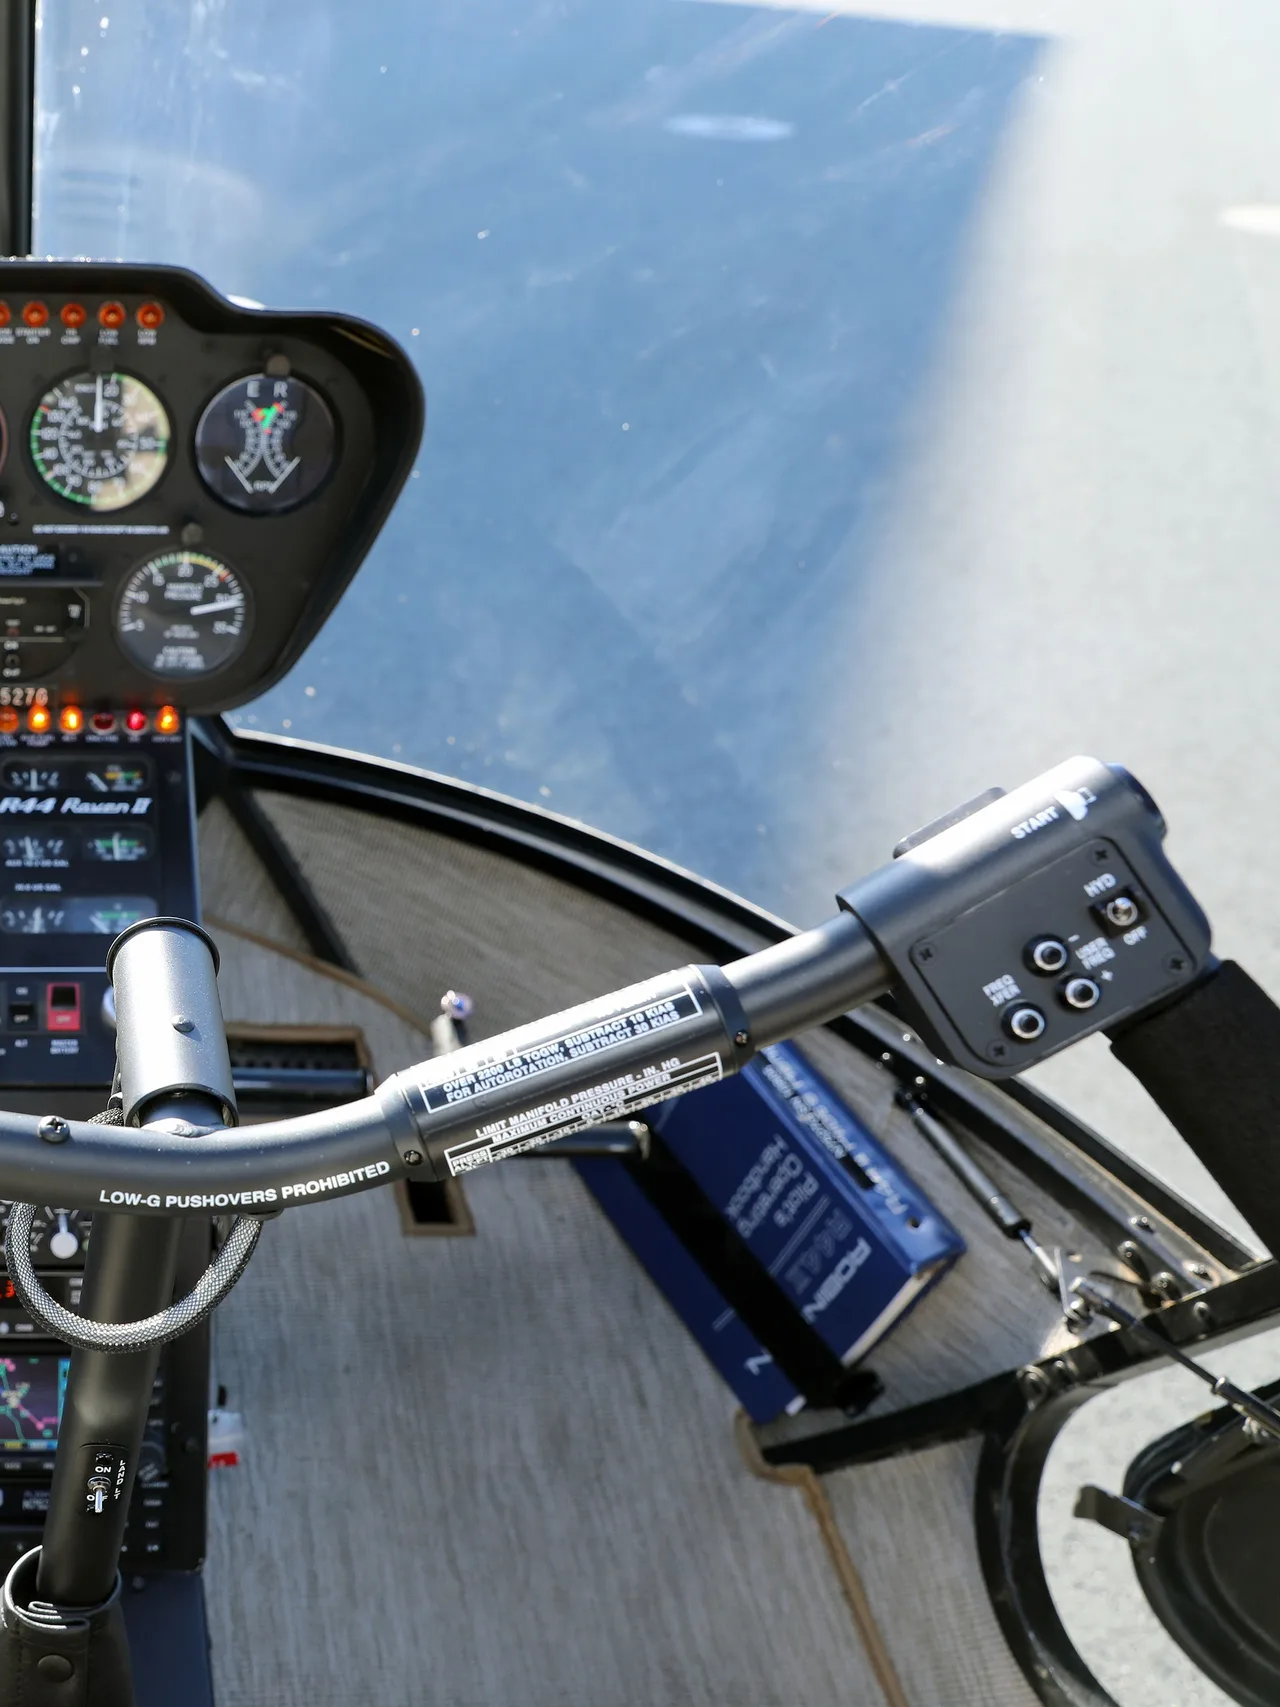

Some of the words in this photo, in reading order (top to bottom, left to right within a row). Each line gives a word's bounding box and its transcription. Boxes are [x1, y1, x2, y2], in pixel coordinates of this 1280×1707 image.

[273, 381, 288, 398] R
[60, 797, 130, 814] Raven
[1010, 806, 1060, 839] START
[1083, 873, 1117, 898] HYD
[1075, 936, 1109, 960] USER
[1123, 925, 1149, 946] OFF
[1080, 945, 1116, 971] FREQ
[982, 973, 1016, 997] FREQ
[442, 1074, 477, 1094] OVER
[477, 1063, 505, 1081] 2200
[506, 1056, 523, 1071] LB
[523, 1043, 565, 1065] TOGW,
[564, 1018, 627, 1048] SUBTRACT
[628, 1012, 645, 1025] 10
[645, 1001, 676, 1019] KIAS
[446, 1084, 472, 1103] FOR
[568, 1028, 632, 1059] SUBTRACT
[633, 1022, 650, 1035] 30
[650, 1010, 681, 1029] KIAS
[475, 1118, 508, 1139] LIMIT
[507, 1097, 570, 1127] MANIFOLD
[570, 1073, 634, 1104] PRESSURE
[642, 1065, 661, 1078] IN.
[660, 1056, 681, 1071] HG
[491, 1117, 548, 1145] MAXIMUM
[548, 1087, 626, 1124] CONTINUOUS
[627, 1072, 672, 1096] POWER
[452, 1148, 488, 1166] PRESS
[99, 1189, 160, 1209] LOW-G
[165, 1188, 278, 1209] PUSHOVERS
[281, 1160, 391, 1201] PROHIBITED
[724, 1133, 790, 1222] Handbook
[736, 1152, 804, 1240] Operating
[773, 1170, 821, 1229] Pilot's
[117, 1459, 127, 1485] LAND
[86, 1494, 109, 1502] OF
[113, 1487, 121, 1499] LT
